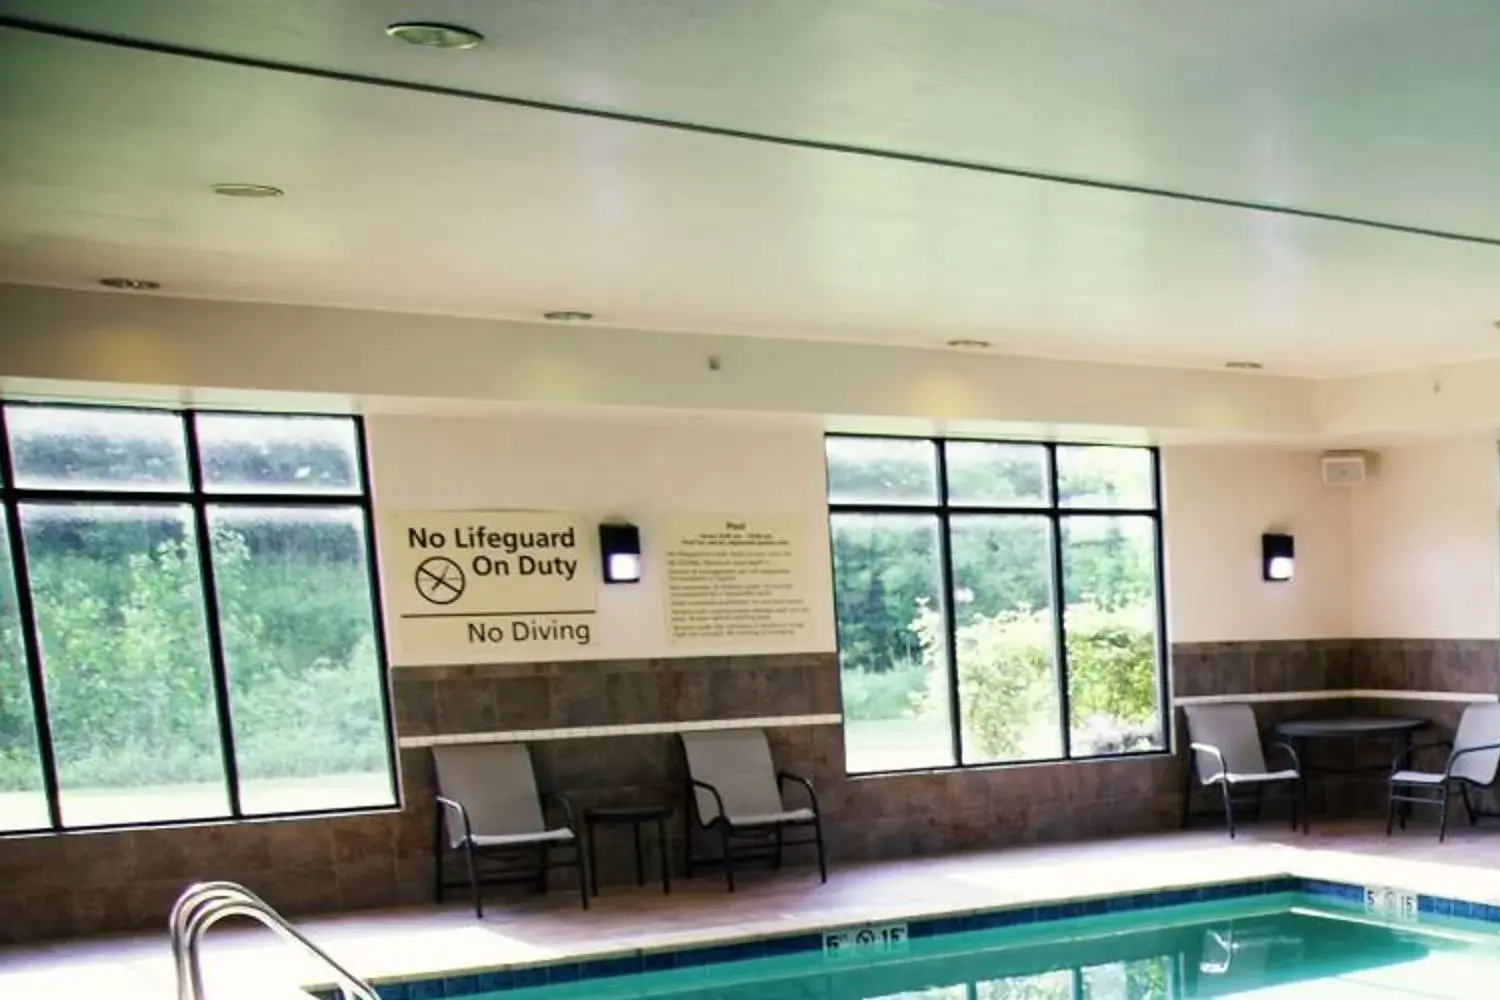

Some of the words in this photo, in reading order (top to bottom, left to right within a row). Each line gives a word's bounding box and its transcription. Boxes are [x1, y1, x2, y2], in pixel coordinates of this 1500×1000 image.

[408, 527, 445, 549] No
[455, 525, 576, 554] Lifeguard
[472, 555, 510, 577] On
[519, 555, 578, 582] Duty
[467, 622, 504, 643] No
[511, 619, 591, 645] Diving
